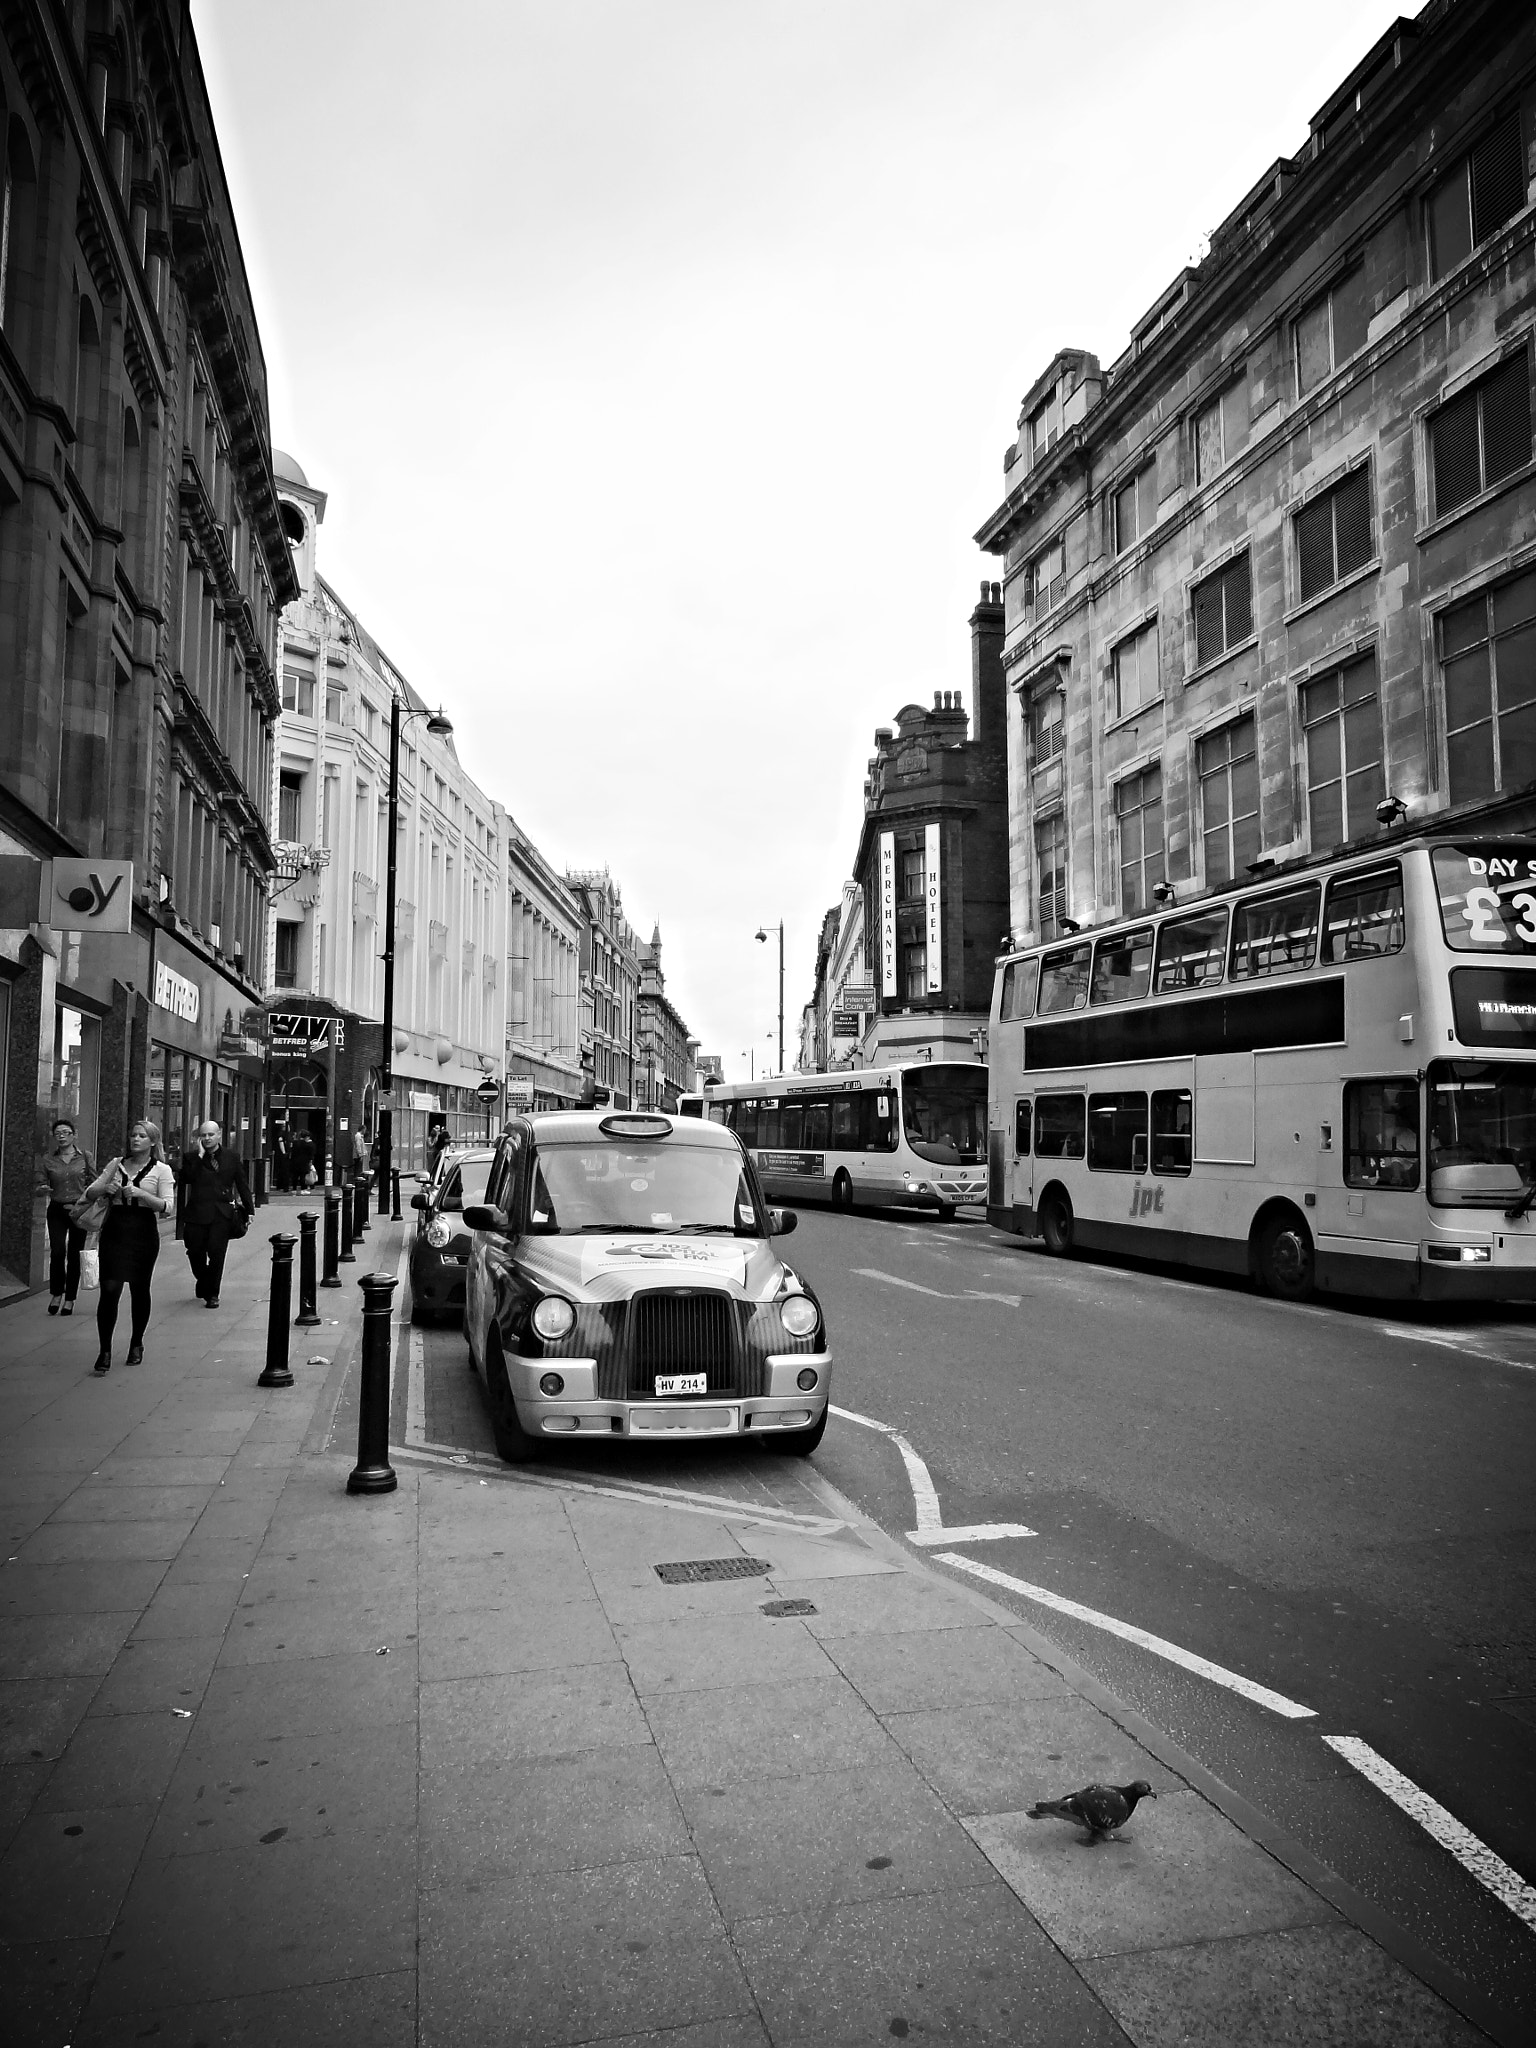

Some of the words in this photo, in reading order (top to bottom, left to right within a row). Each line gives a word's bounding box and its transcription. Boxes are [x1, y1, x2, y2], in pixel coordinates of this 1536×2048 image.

[1468, 857, 1518, 877] DAY
[883, 850, 892, 979] MERCHANTS
[929, 872, 937, 943] HOTEL
[155, 960, 200, 1023] BETFRED
[273, 1037, 307, 1045] BETFRED
[1129, 1180, 1164, 1218] jpt
[637, 1247, 719, 1258] CAPITAL
[661, 1380, 674, 1390] HV
[681, 1379, 699, 1389] 214
